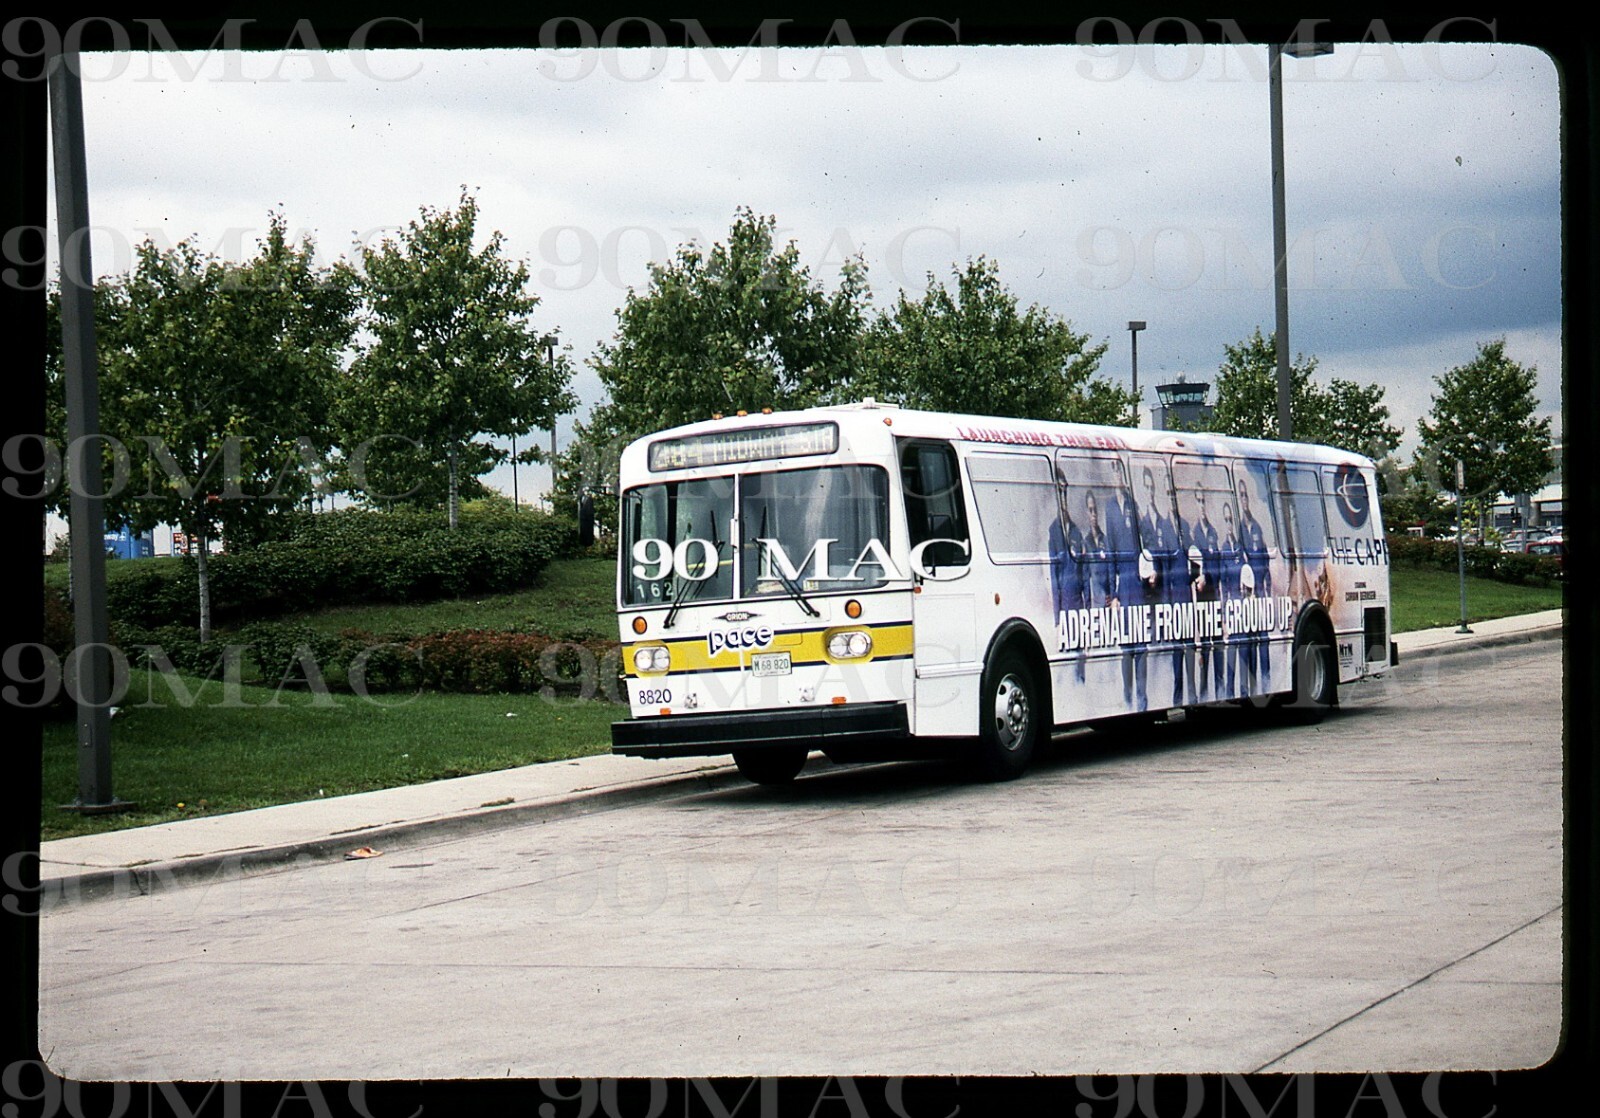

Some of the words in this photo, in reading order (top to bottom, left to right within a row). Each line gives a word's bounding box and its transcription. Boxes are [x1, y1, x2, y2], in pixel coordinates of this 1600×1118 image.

[956, 427, 1053, 446] LAUNCHING
[1056, 434, 1092, 448] THIS
[1098, 435, 1131, 449] FALL
[1329, 537, 1354, 564] THE
[636, 581, 674, 599] 162
[726, 612, 748, 621] ORION
[1058, 605, 1151, 652] ADRENALINE
[1155, 602, 1194, 641] FROM
[1196, 600, 1222, 637] THE
[1225, 597, 1275, 635] GROUND
[1278, 596, 1293, 631] UP
[708, 625, 773, 656] pace
[761, 659, 772, 670] 68
[774, 658, 789, 669] 820
[638, 689, 672, 705] 8820
